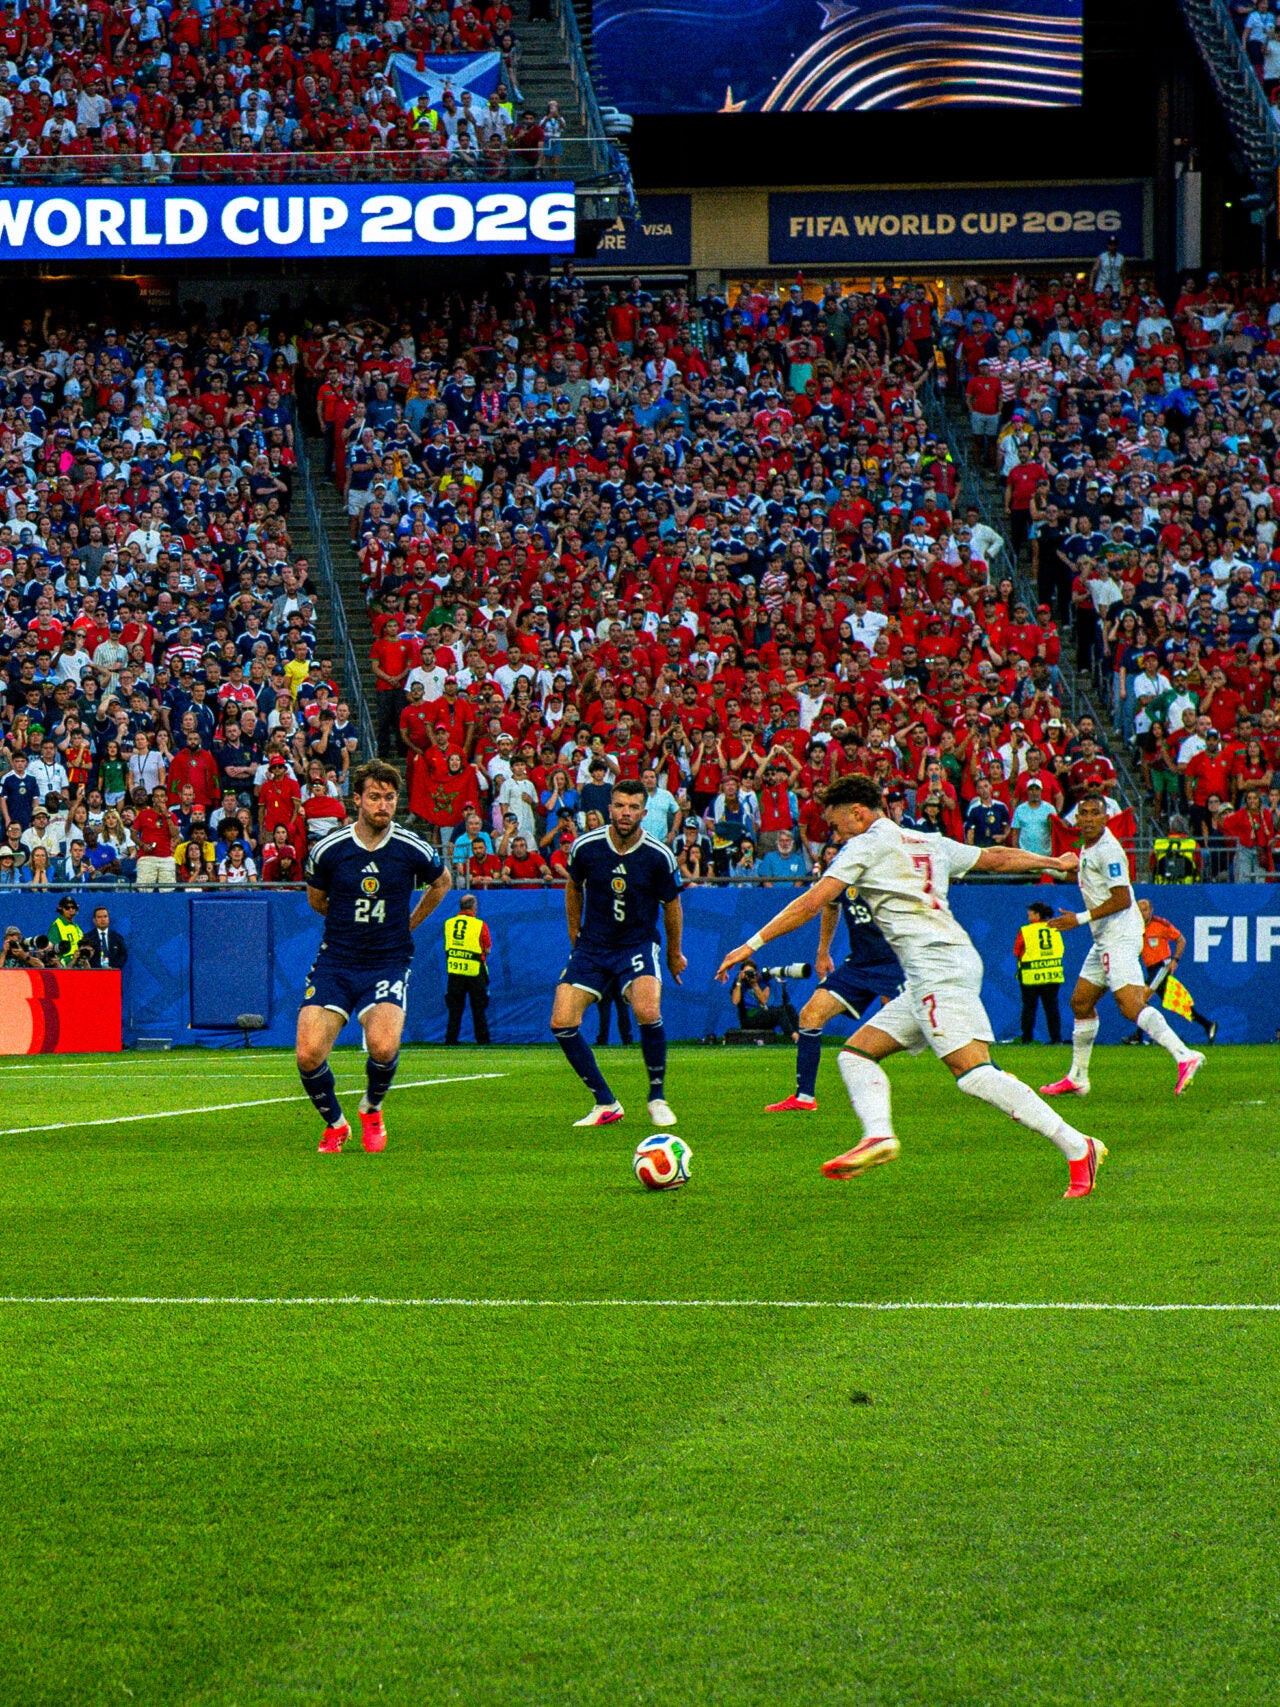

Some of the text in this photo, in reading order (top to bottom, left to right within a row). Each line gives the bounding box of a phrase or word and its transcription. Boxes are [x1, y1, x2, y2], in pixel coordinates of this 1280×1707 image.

[221, 196, 349, 245] CUP
[361, 193, 575, 243] 2026
[642, 224, 673, 236] VISA
[789, 210, 1121, 238] FIFA WORLD CUP 2026
[354, 898, 387, 924] 24
[613, 899, 626, 922] 5
[848, 904, 872, 925] 19
[1193, 916, 1280, 962] FIF
[631, 953, 645, 973] 5
[1102, 952, 1110, 975] 9
[375, 979, 404, 1001] 24
[922, 992, 938, 1029] 7
